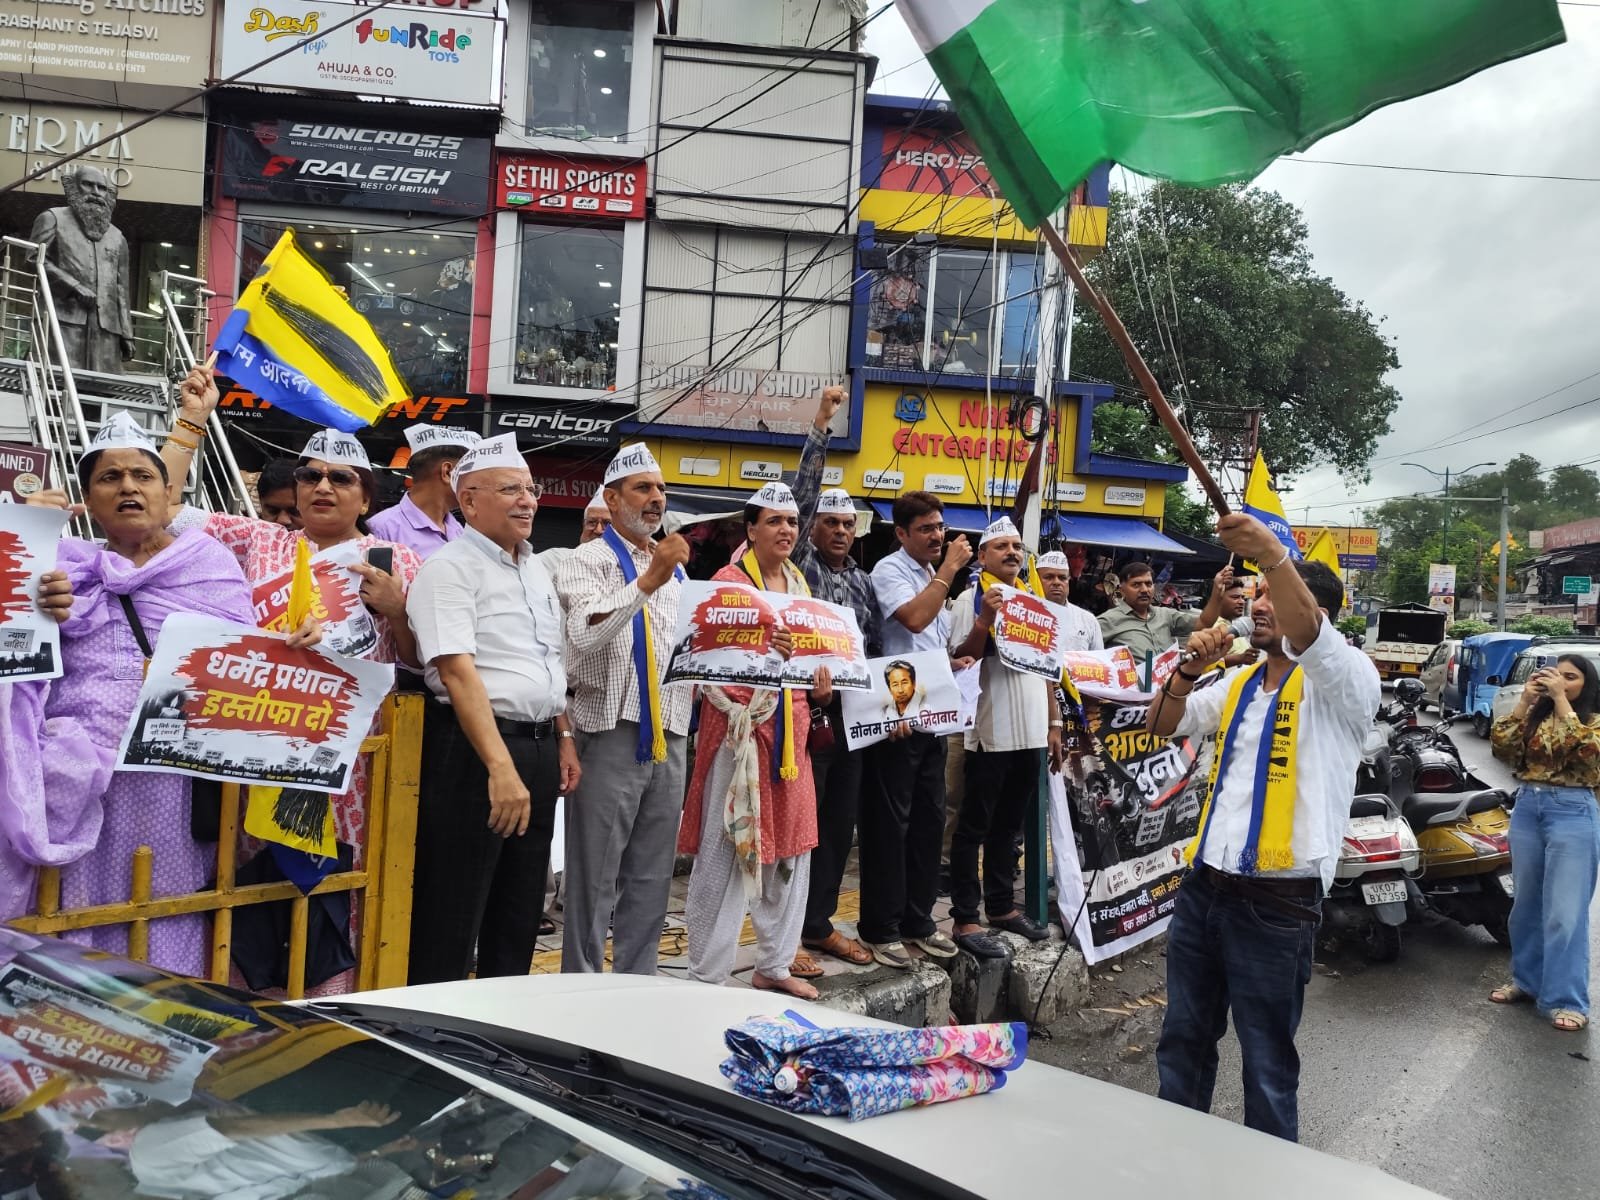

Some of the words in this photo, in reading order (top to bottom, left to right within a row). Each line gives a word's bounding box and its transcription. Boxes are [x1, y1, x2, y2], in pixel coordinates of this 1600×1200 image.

[0, 14, 74, 32] RASHANT
[78, 19, 89, 34] &
[93, 21, 159, 41] TEJASVI
[244, 8, 319, 35] Dash
[27, 41, 57, 52] CANDID
[58, 45, 115, 57] PHOTOGRAPHY
[121, 50, 191, 64] CINEMATOGRAPHY
[428, 50, 460, 64] TOYS
[29, 55, 61, 66] FASHION
[63, 58, 106, 70] PORTFOLIO
[116, 63, 146, 73] EVENTS
[317, 61, 360, 75] AHUJA
[363, 65, 372, 76] &
[375, 66, 397, 78] CO.
[0, 112, 134, 160] ERMA
[289, 124, 464, 150] SUNCROSS
[413, 149, 458, 160] BIKES
[896, 150, 951, 169] HERO
[300, 159, 451, 186] RALEIGH
[505, 164, 559, 191] SETHI
[565, 169, 636, 197] SPORTS
[360, 181, 382, 191] BEST
[385, 183, 397, 192] OF
[399, 185, 440, 196] BRITAIN
[737, 398, 791, 412] STAIR
[480, 442, 503, 456] पार्टी
[893, 427, 1058, 465] ENTERPRISS
[743, 470, 779, 479] HERCULES
[866, 474, 902, 486] Octane
[705, 607, 760, 625] अत्याचार
[736, 625, 765, 646] करो
[272, 663, 347, 698] प्रधान
[201, 688, 304, 727] इस्तीफा
[304, 699, 333, 731] दो
[1277, 701, 1295, 710] OTE
[1276, 713, 1290, 723] OR
[850, 721, 882, 740] सोनम
[1127, 742, 1186, 801] सुनो
[1370, 882, 1396, 893] UK07
